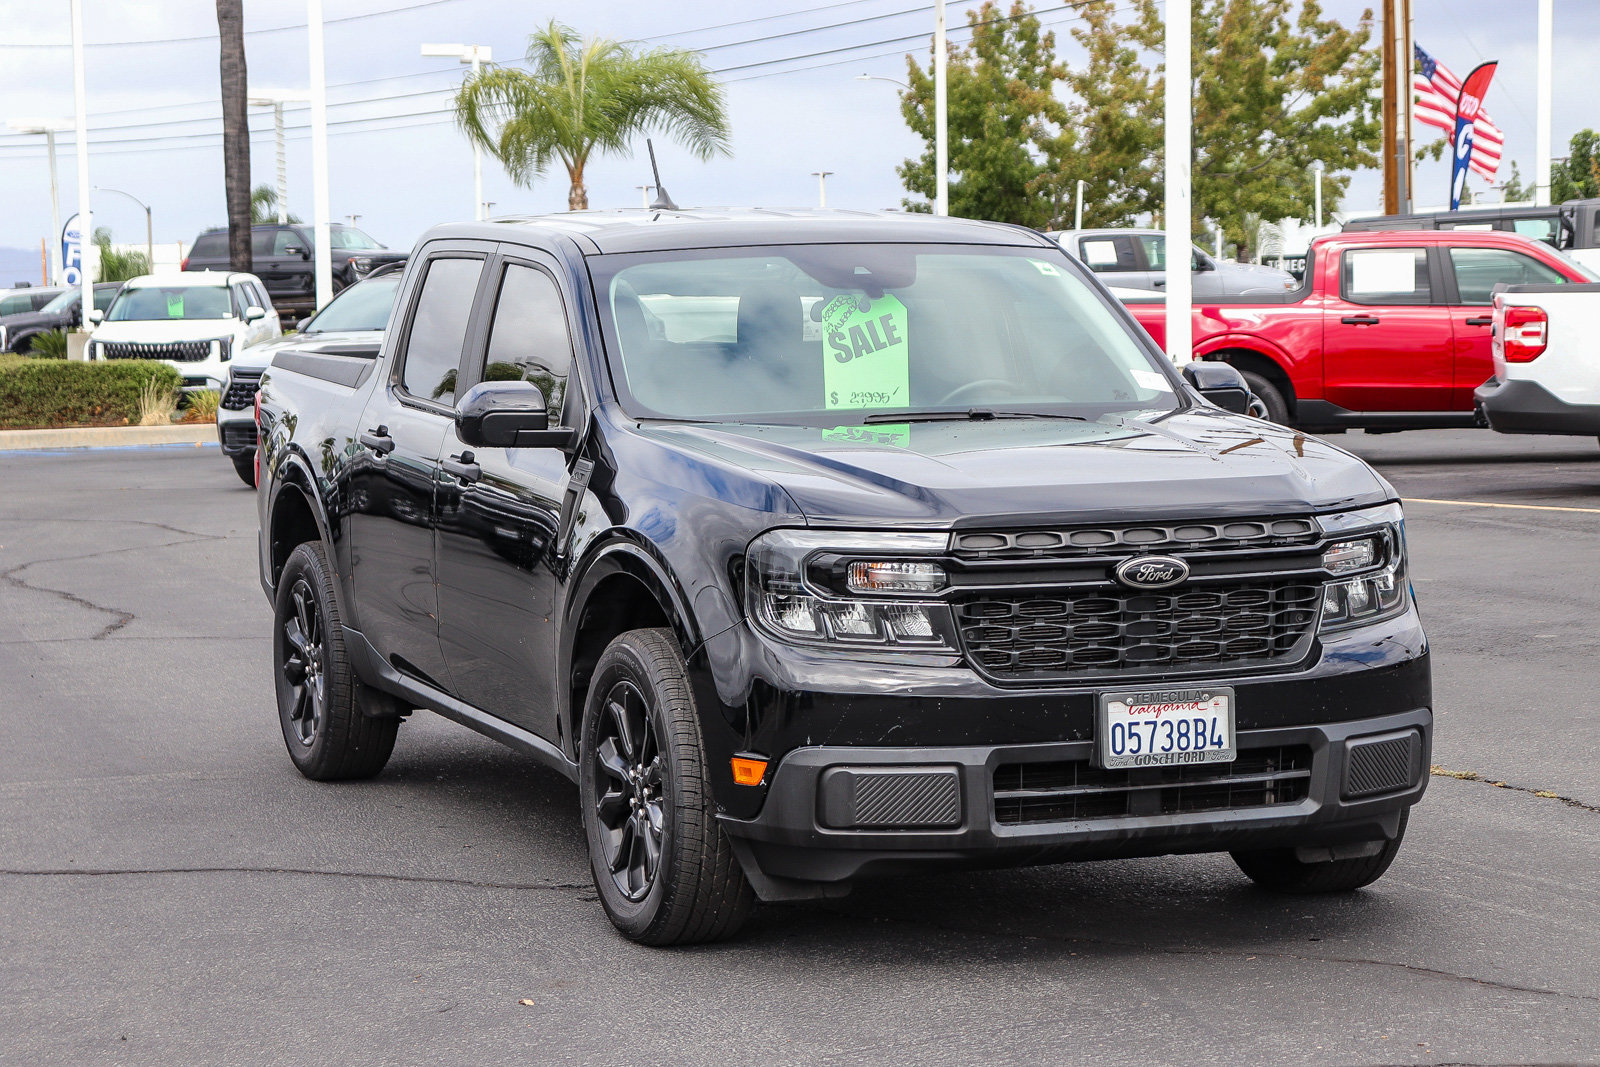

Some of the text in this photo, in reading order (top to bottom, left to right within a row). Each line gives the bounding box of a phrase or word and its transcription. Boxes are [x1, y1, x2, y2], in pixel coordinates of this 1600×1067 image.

[828, 313, 902, 363] SALE
[830, 391, 839, 405] $
[1136, 563, 1174, 582] Ford
[1133, 691, 1203, 704] TEMECULA
[1128, 702, 1208, 718] California
[1111, 717, 1224, 755] 05738B4
[1177, 751, 1206, 763] FORD
